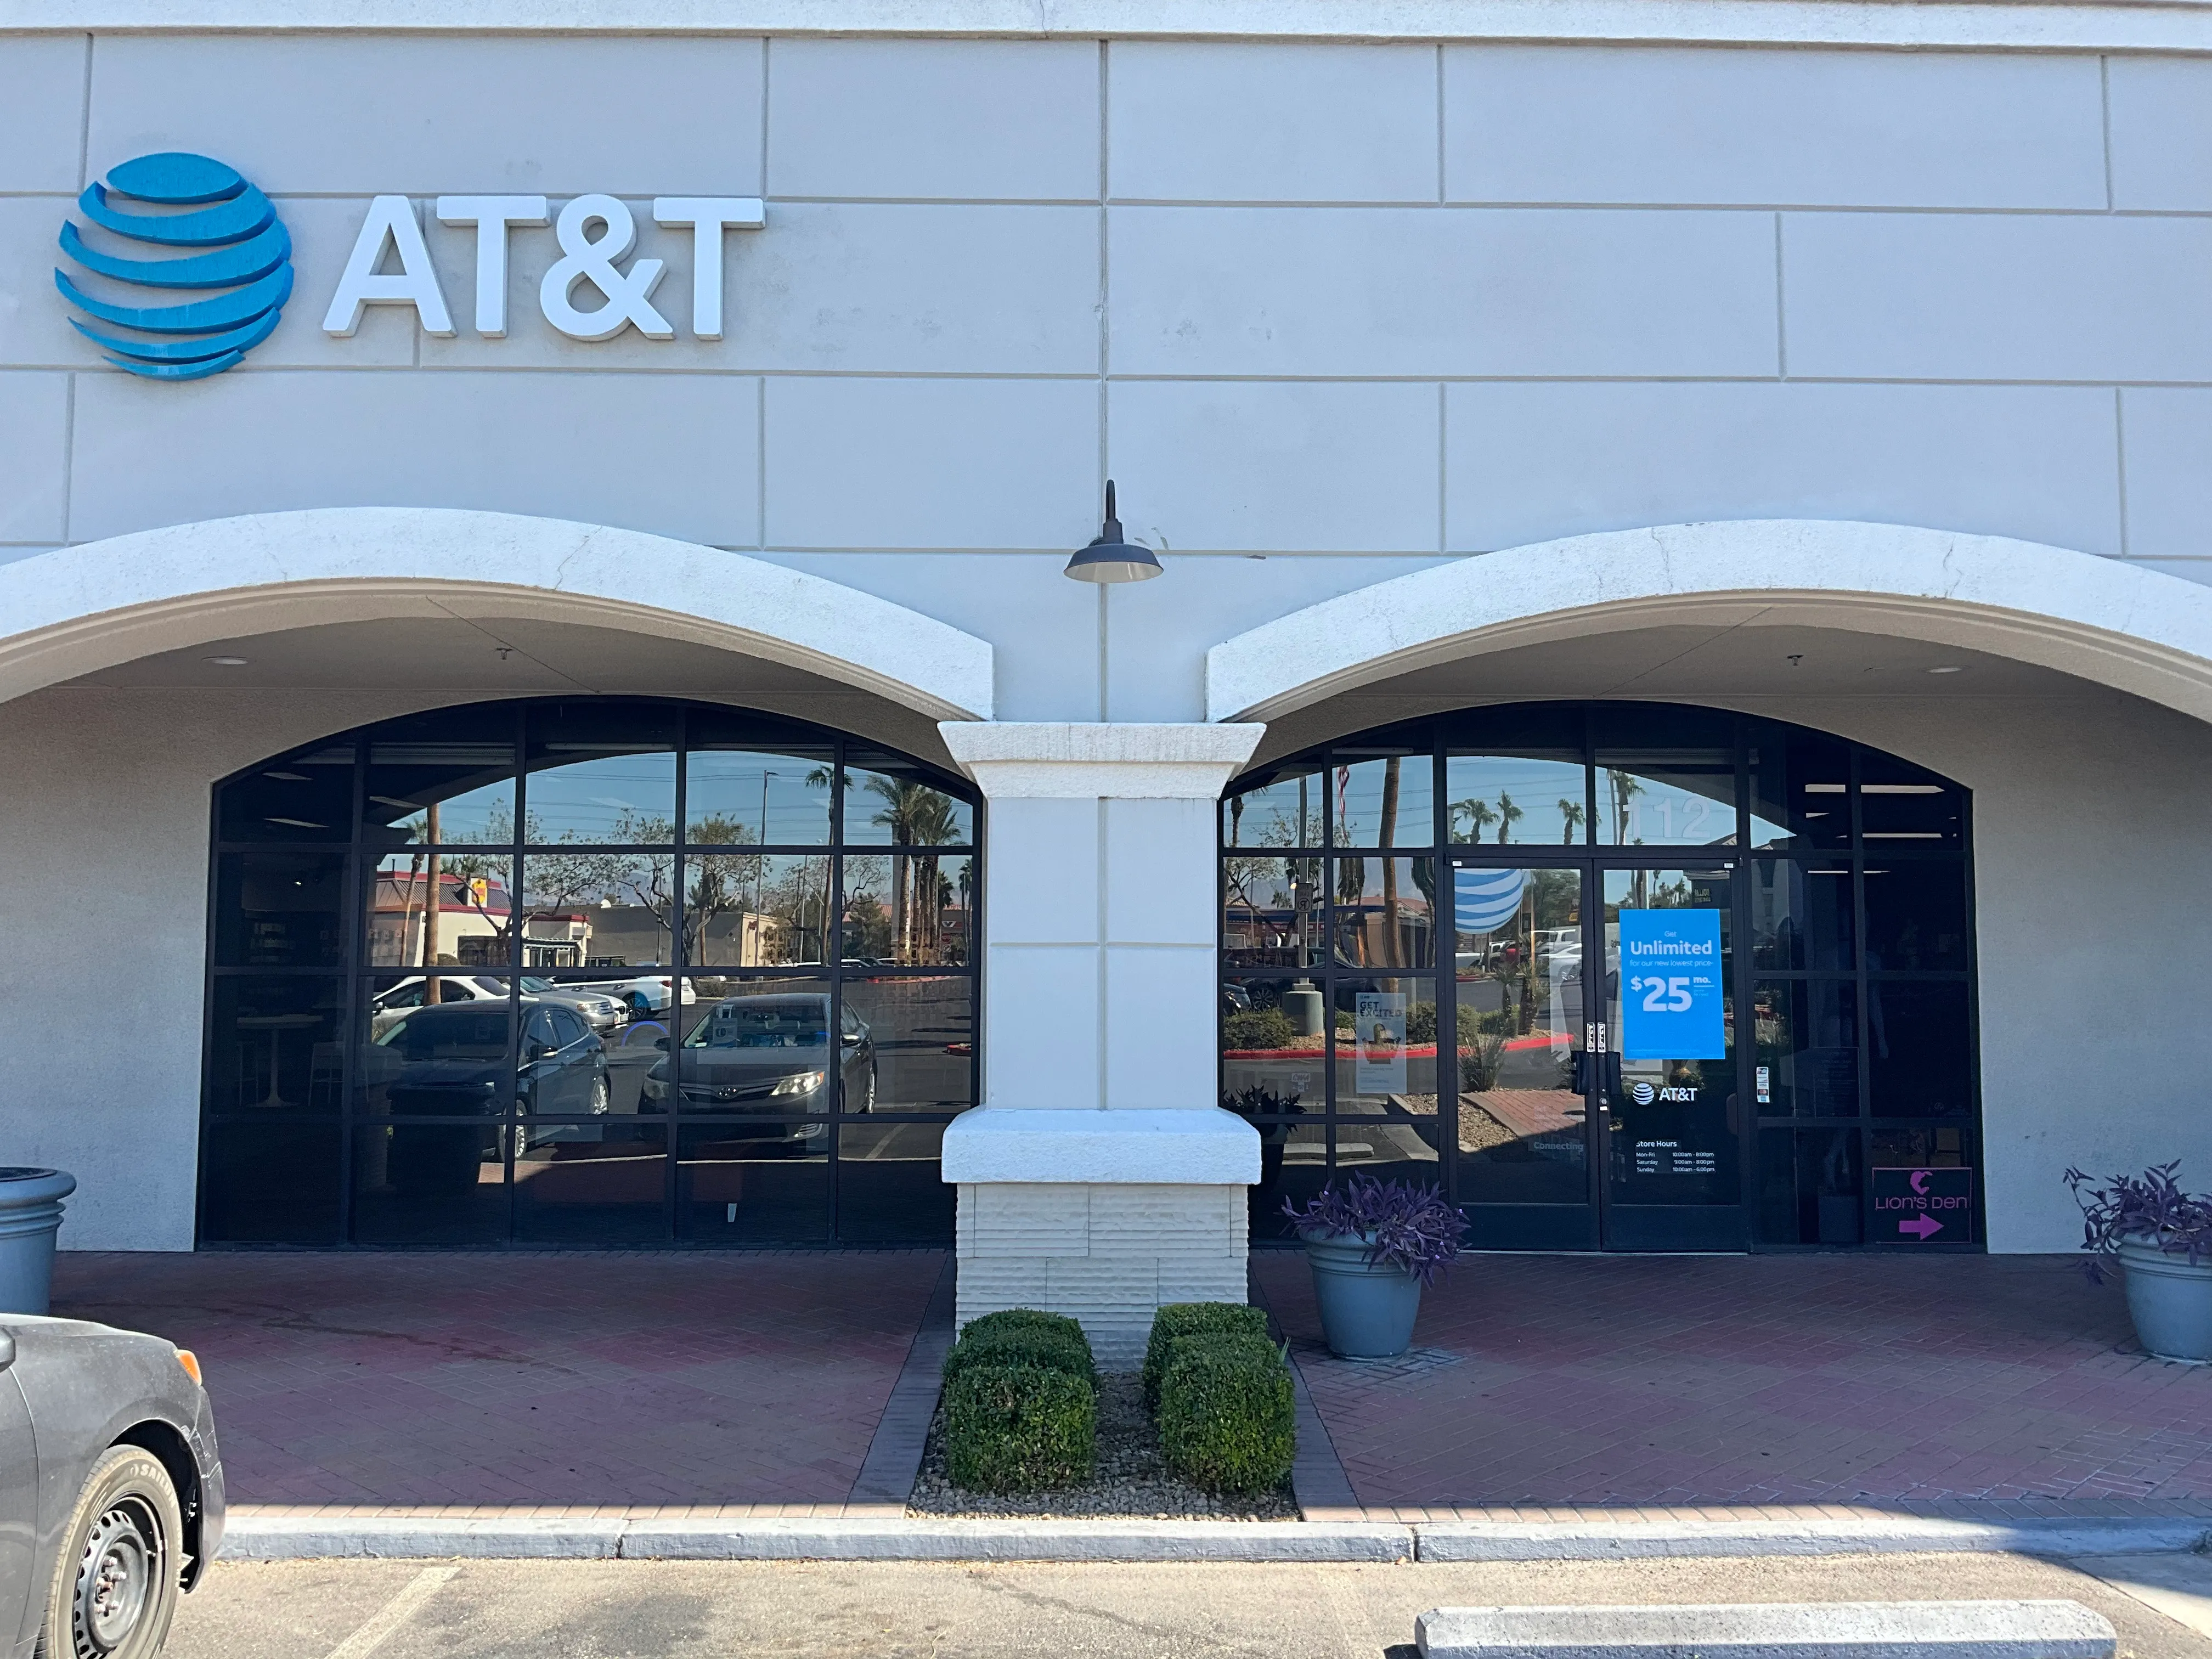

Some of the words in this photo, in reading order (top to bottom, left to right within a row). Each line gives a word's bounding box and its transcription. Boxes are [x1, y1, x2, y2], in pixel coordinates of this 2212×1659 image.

[323, 194, 766, 341] AT&T
[1622, 796, 1711, 838] 112
[1630, 940, 1712, 955] Unlimited
[1360, 1001, 1379, 1009] GET
[1630, 975, 1692, 1012] $25
[1658, 1087, 1698, 1101] AT&T
[140, 1464, 176, 1509] SAILUN
